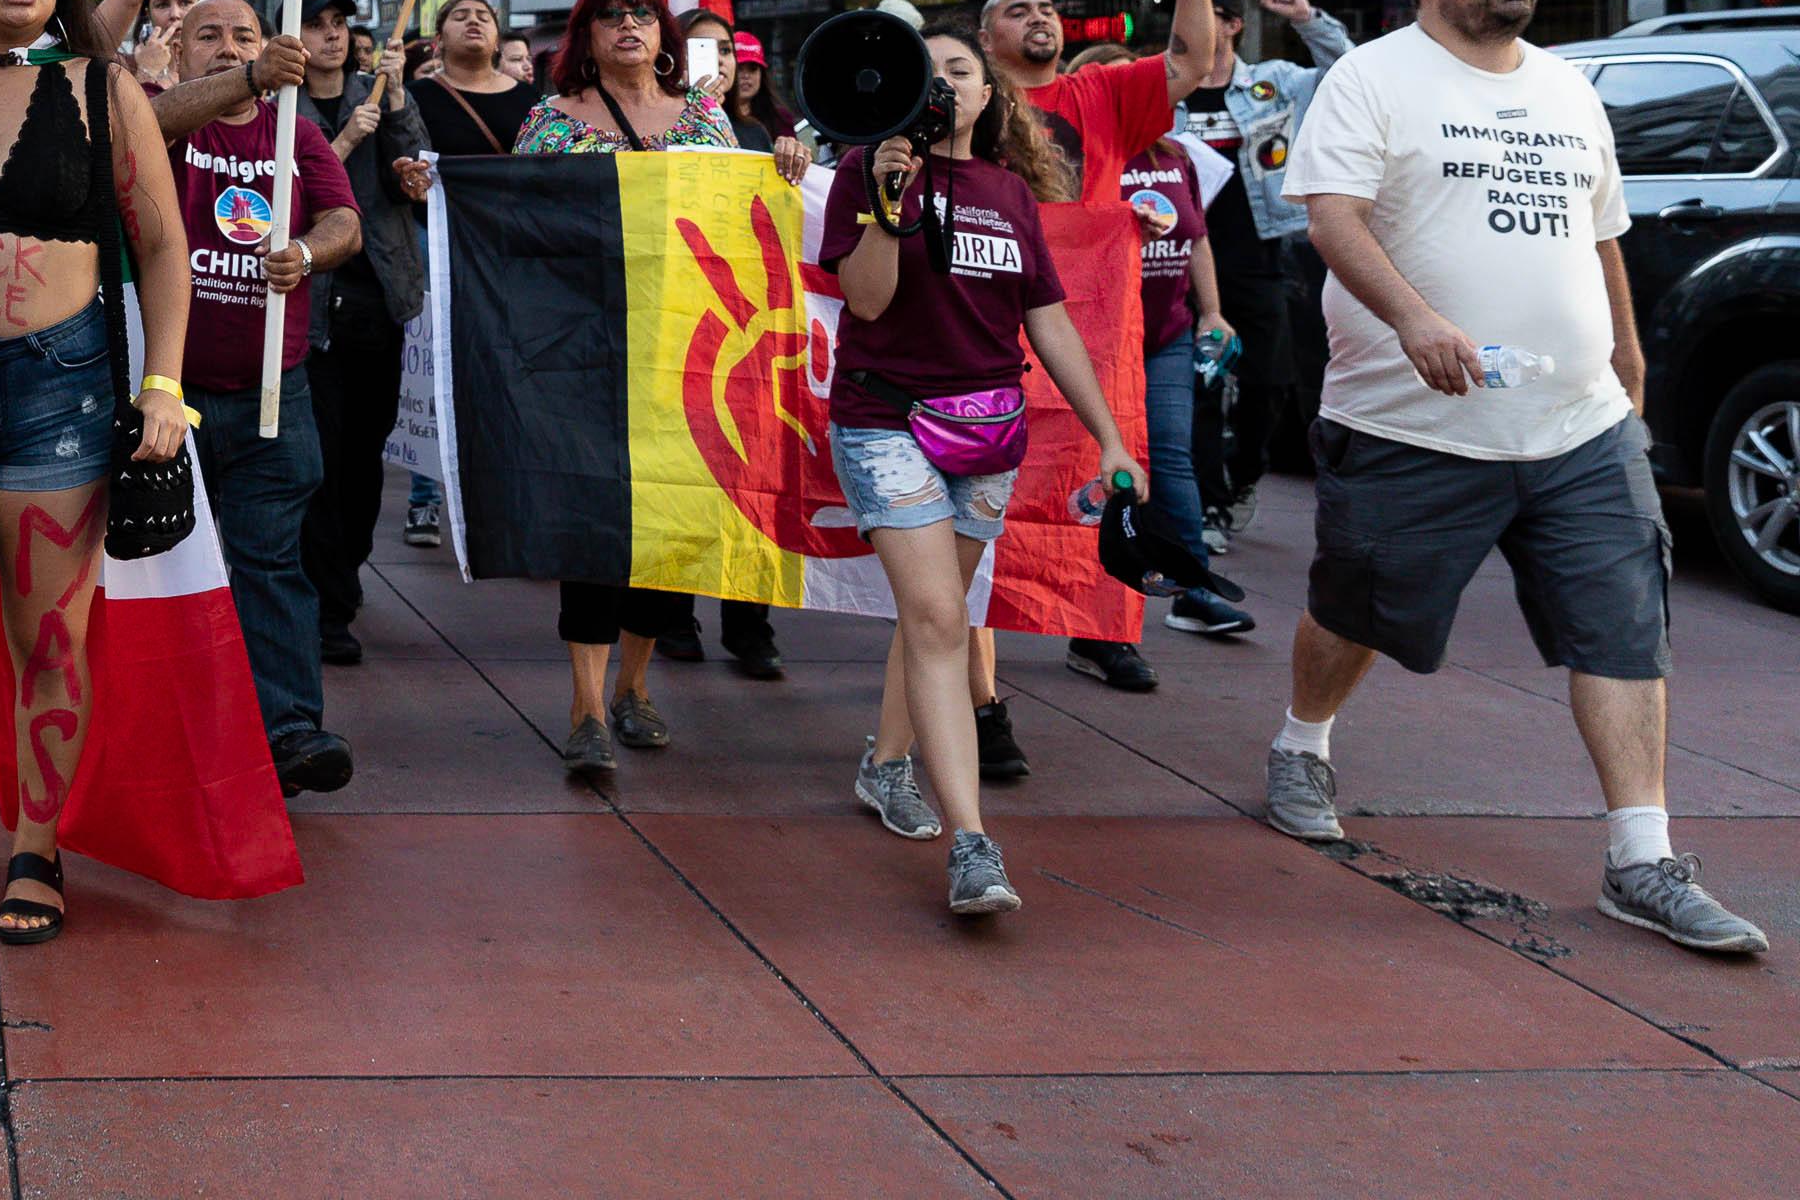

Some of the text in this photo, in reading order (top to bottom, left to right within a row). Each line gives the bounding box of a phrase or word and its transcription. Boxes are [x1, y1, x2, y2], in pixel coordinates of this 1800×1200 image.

[1441, 123, 1588, 151] IMMIGRANTS
[1502, 150, 1543, 166] AND
[1442, 161, 1568, 187] REFUGEES
[1487, 189, 1568, 209] RACISTS
[1487, 208, 1570, 238] OUT!
[190, 274, 234, 291] Coalition
[235, 280, 251, 293] for
[196, 289, 249, 305] Immigrant
[16, 487, 100, 825] MAS
